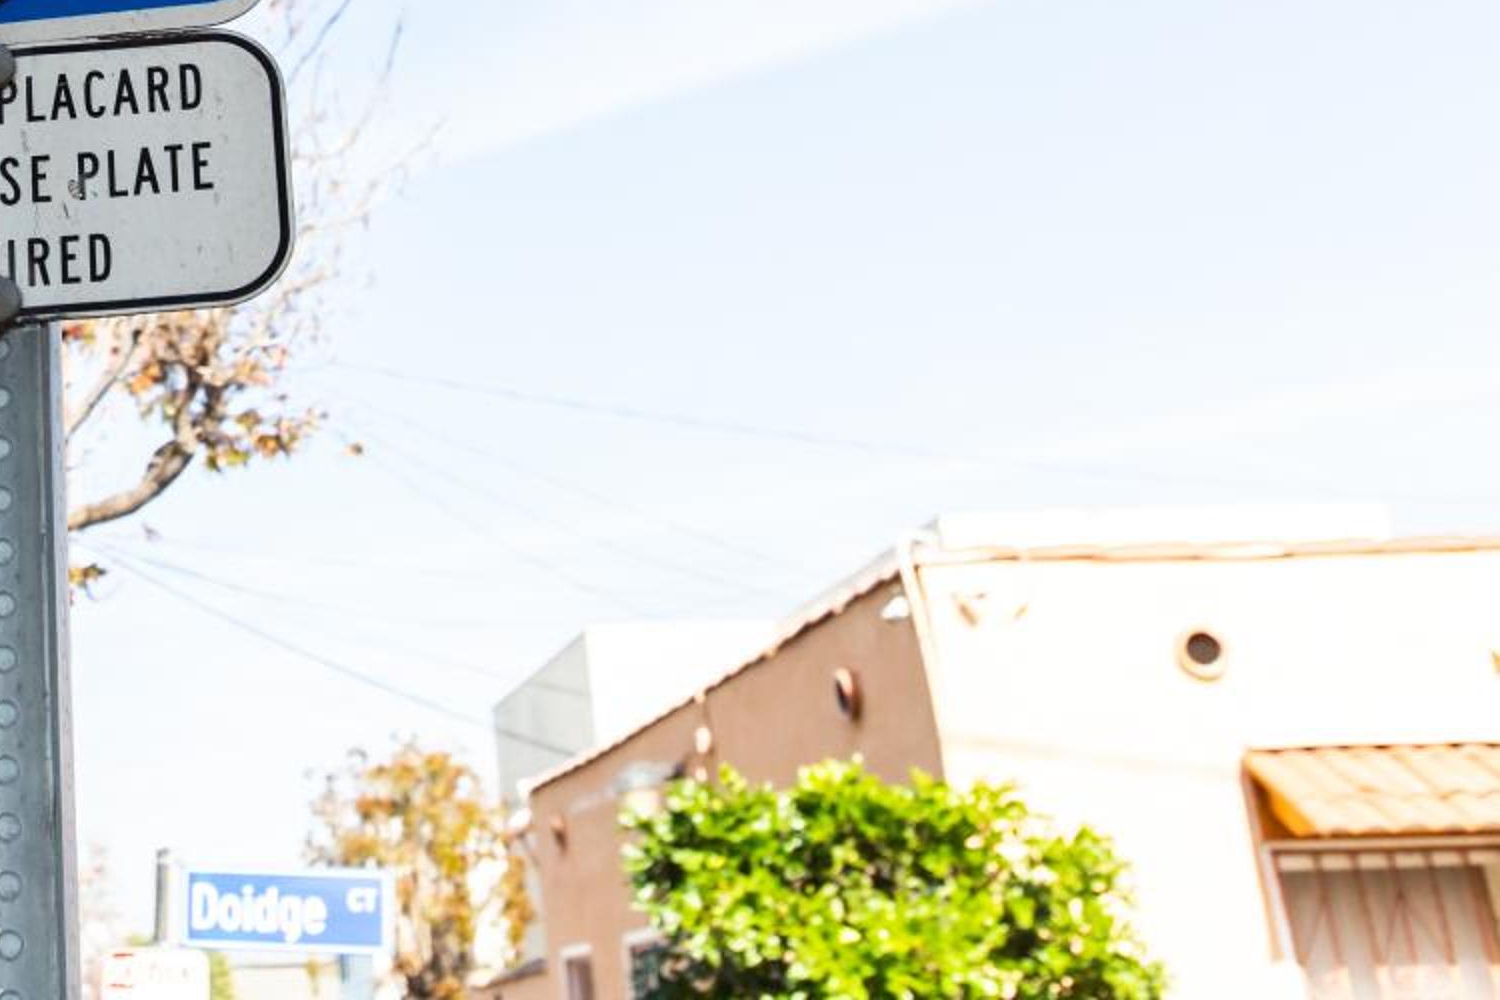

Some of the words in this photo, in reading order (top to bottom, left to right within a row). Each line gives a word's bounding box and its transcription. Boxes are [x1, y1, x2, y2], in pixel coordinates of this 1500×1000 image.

[76, 142, 215, 201] PLATE
[191, 881, 327, 943] Doidge
[346, 887, 377, 914] CT
